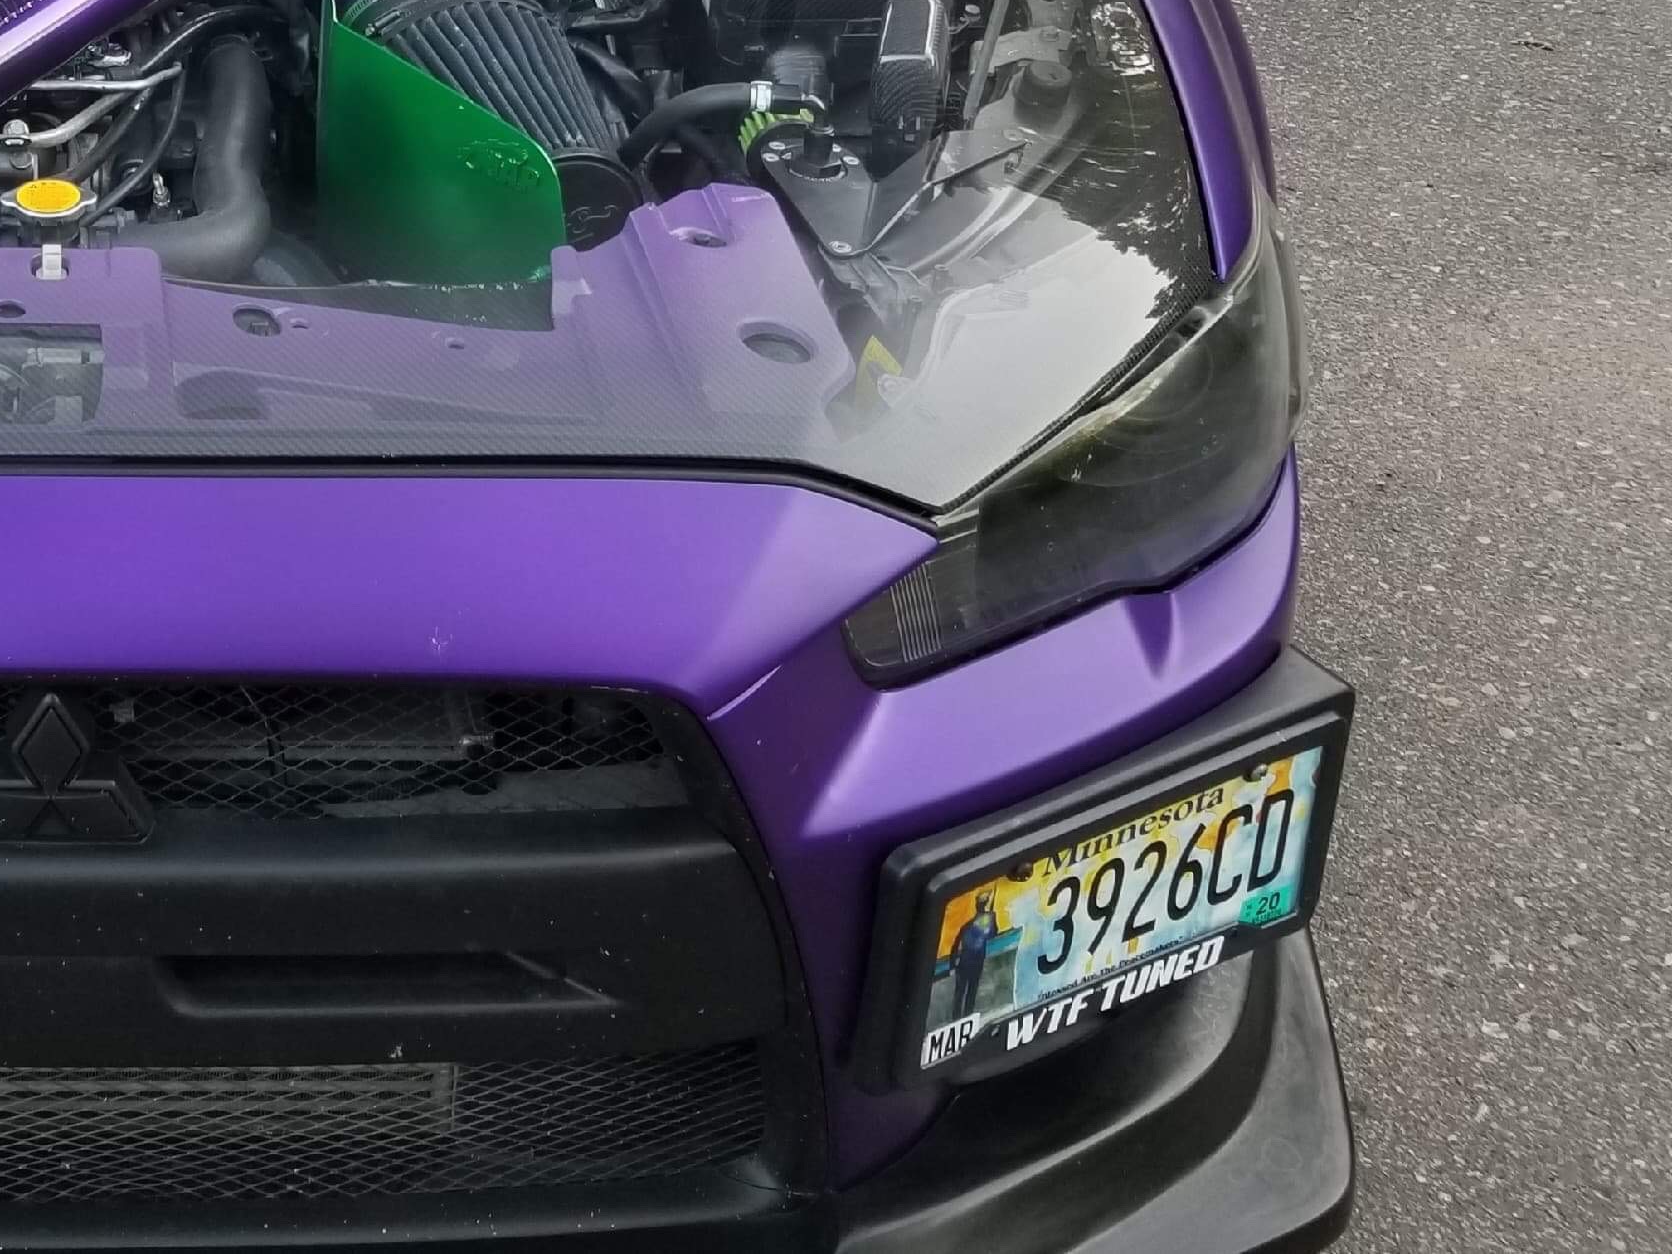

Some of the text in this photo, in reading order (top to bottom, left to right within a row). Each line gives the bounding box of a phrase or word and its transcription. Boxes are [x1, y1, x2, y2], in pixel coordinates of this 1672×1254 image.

[1042, 784, 1225, 876] Minnesota
[1037, 788, 1294, 974] 3926CD
[1256, 892, 1280, 915] 20
[1006, 935, 1225, 1051] WTF TUNED
[928, 1020, 974, 1064] MAR
